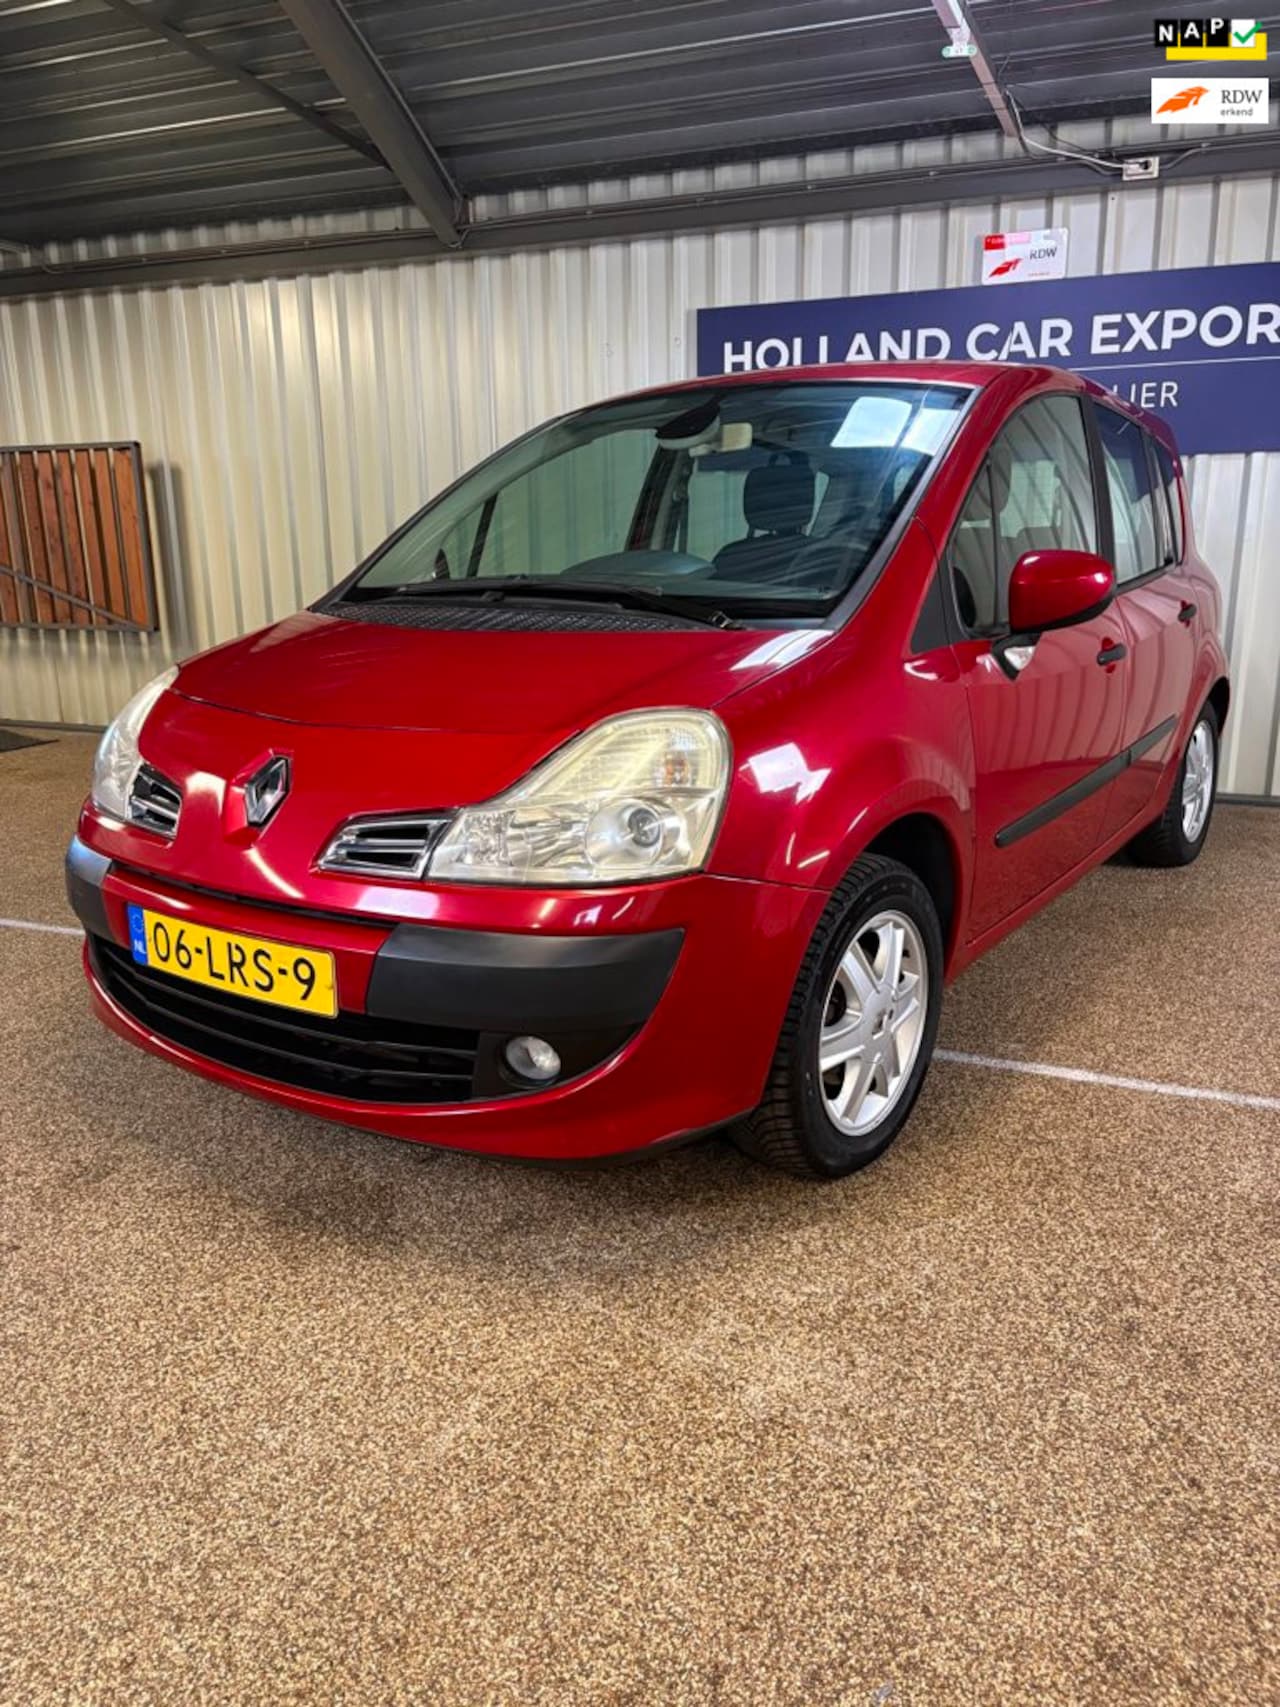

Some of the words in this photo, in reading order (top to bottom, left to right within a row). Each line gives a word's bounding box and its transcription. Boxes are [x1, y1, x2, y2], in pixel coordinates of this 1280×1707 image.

[1029, 247, 1057, 260] RDW
[966, 318, 1073, 361] CAR
[134, 940, 146, 954] NL
[153, 921, 316, 1001] 06-LRS-9
